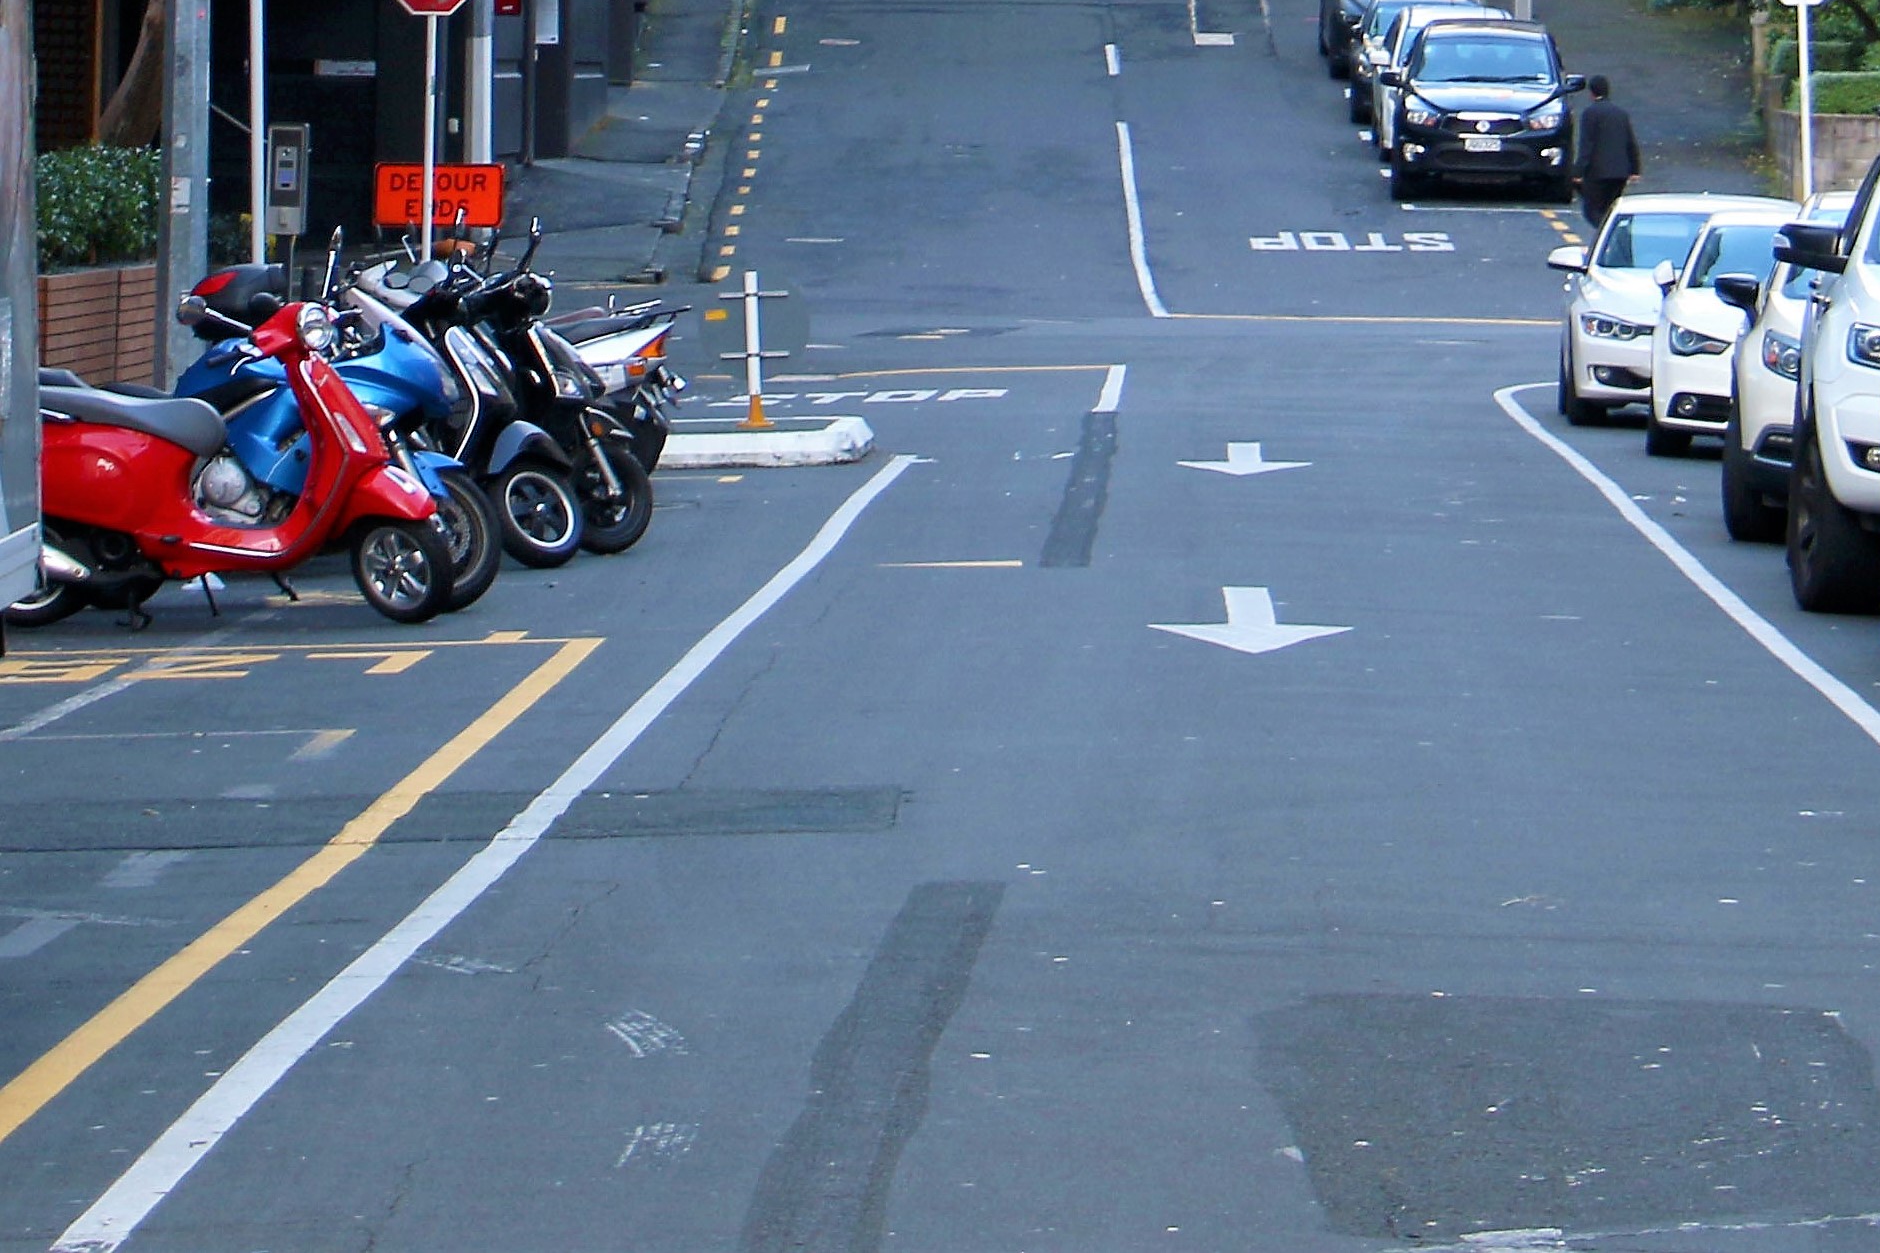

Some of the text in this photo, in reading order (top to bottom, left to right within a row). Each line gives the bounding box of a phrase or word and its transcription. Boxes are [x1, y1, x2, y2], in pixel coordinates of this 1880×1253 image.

[389, 172, 487, 192] DEOUR
[404, 198, 470, 217] EDS
[1249, 231, 1456, 251] STOP
[706, 389, 1009, 408] STOP
